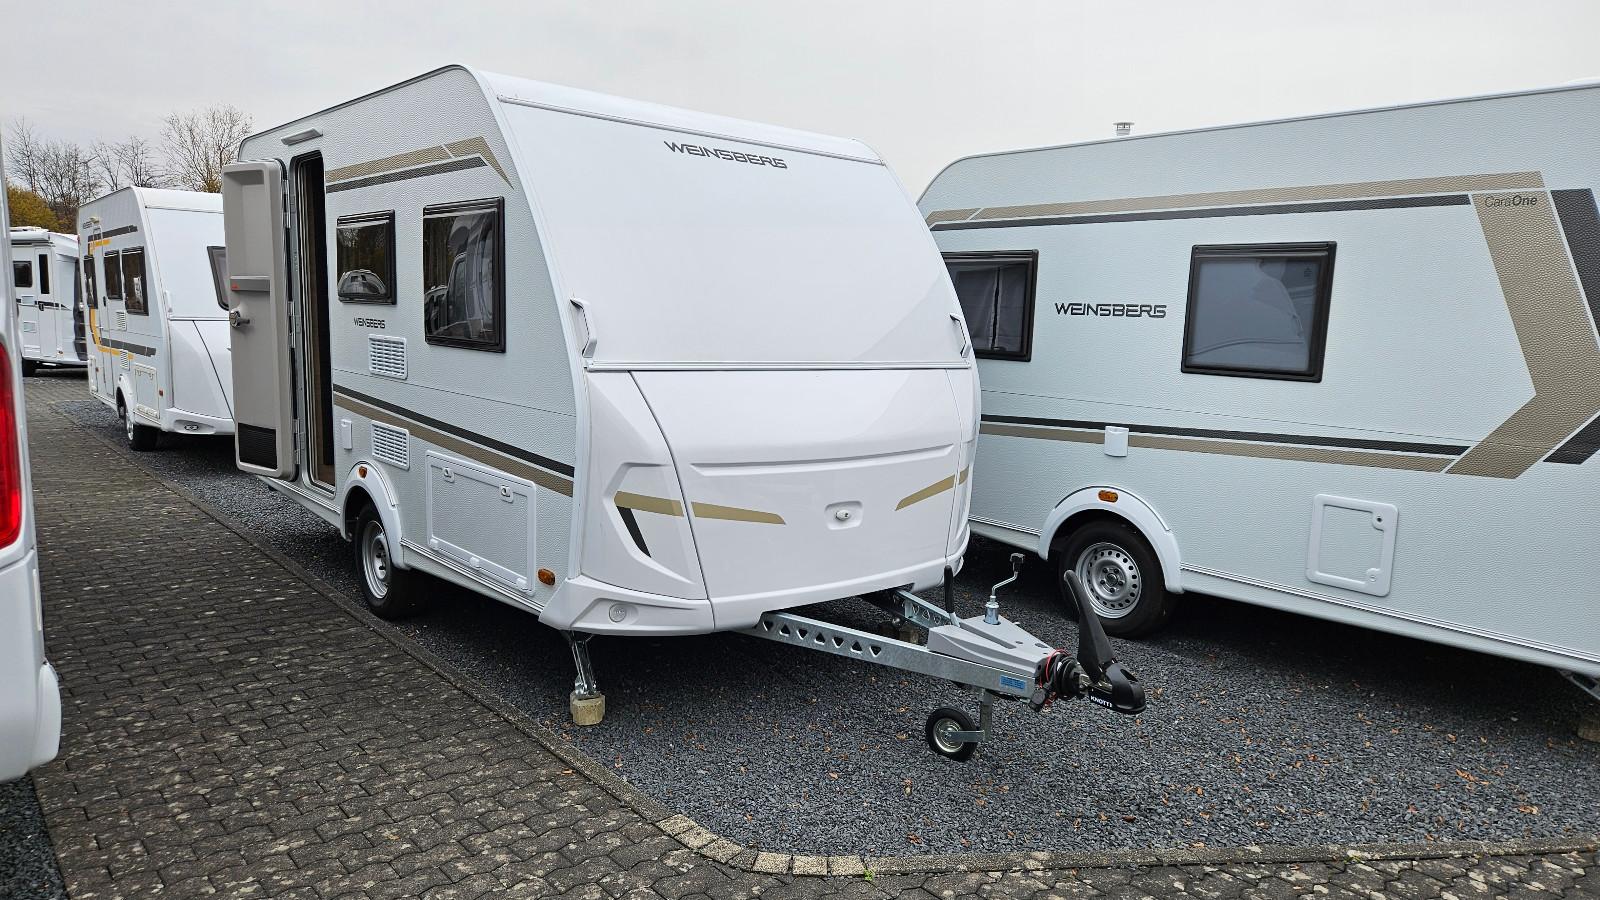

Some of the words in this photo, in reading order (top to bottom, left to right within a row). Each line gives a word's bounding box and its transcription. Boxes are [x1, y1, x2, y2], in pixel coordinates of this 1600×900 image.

[664, 141, 788, 169] WEINSBERG
[1484, 195, 1538, 208] CaraOne
[1054, 302, 1167, 318] WEINSBERG
